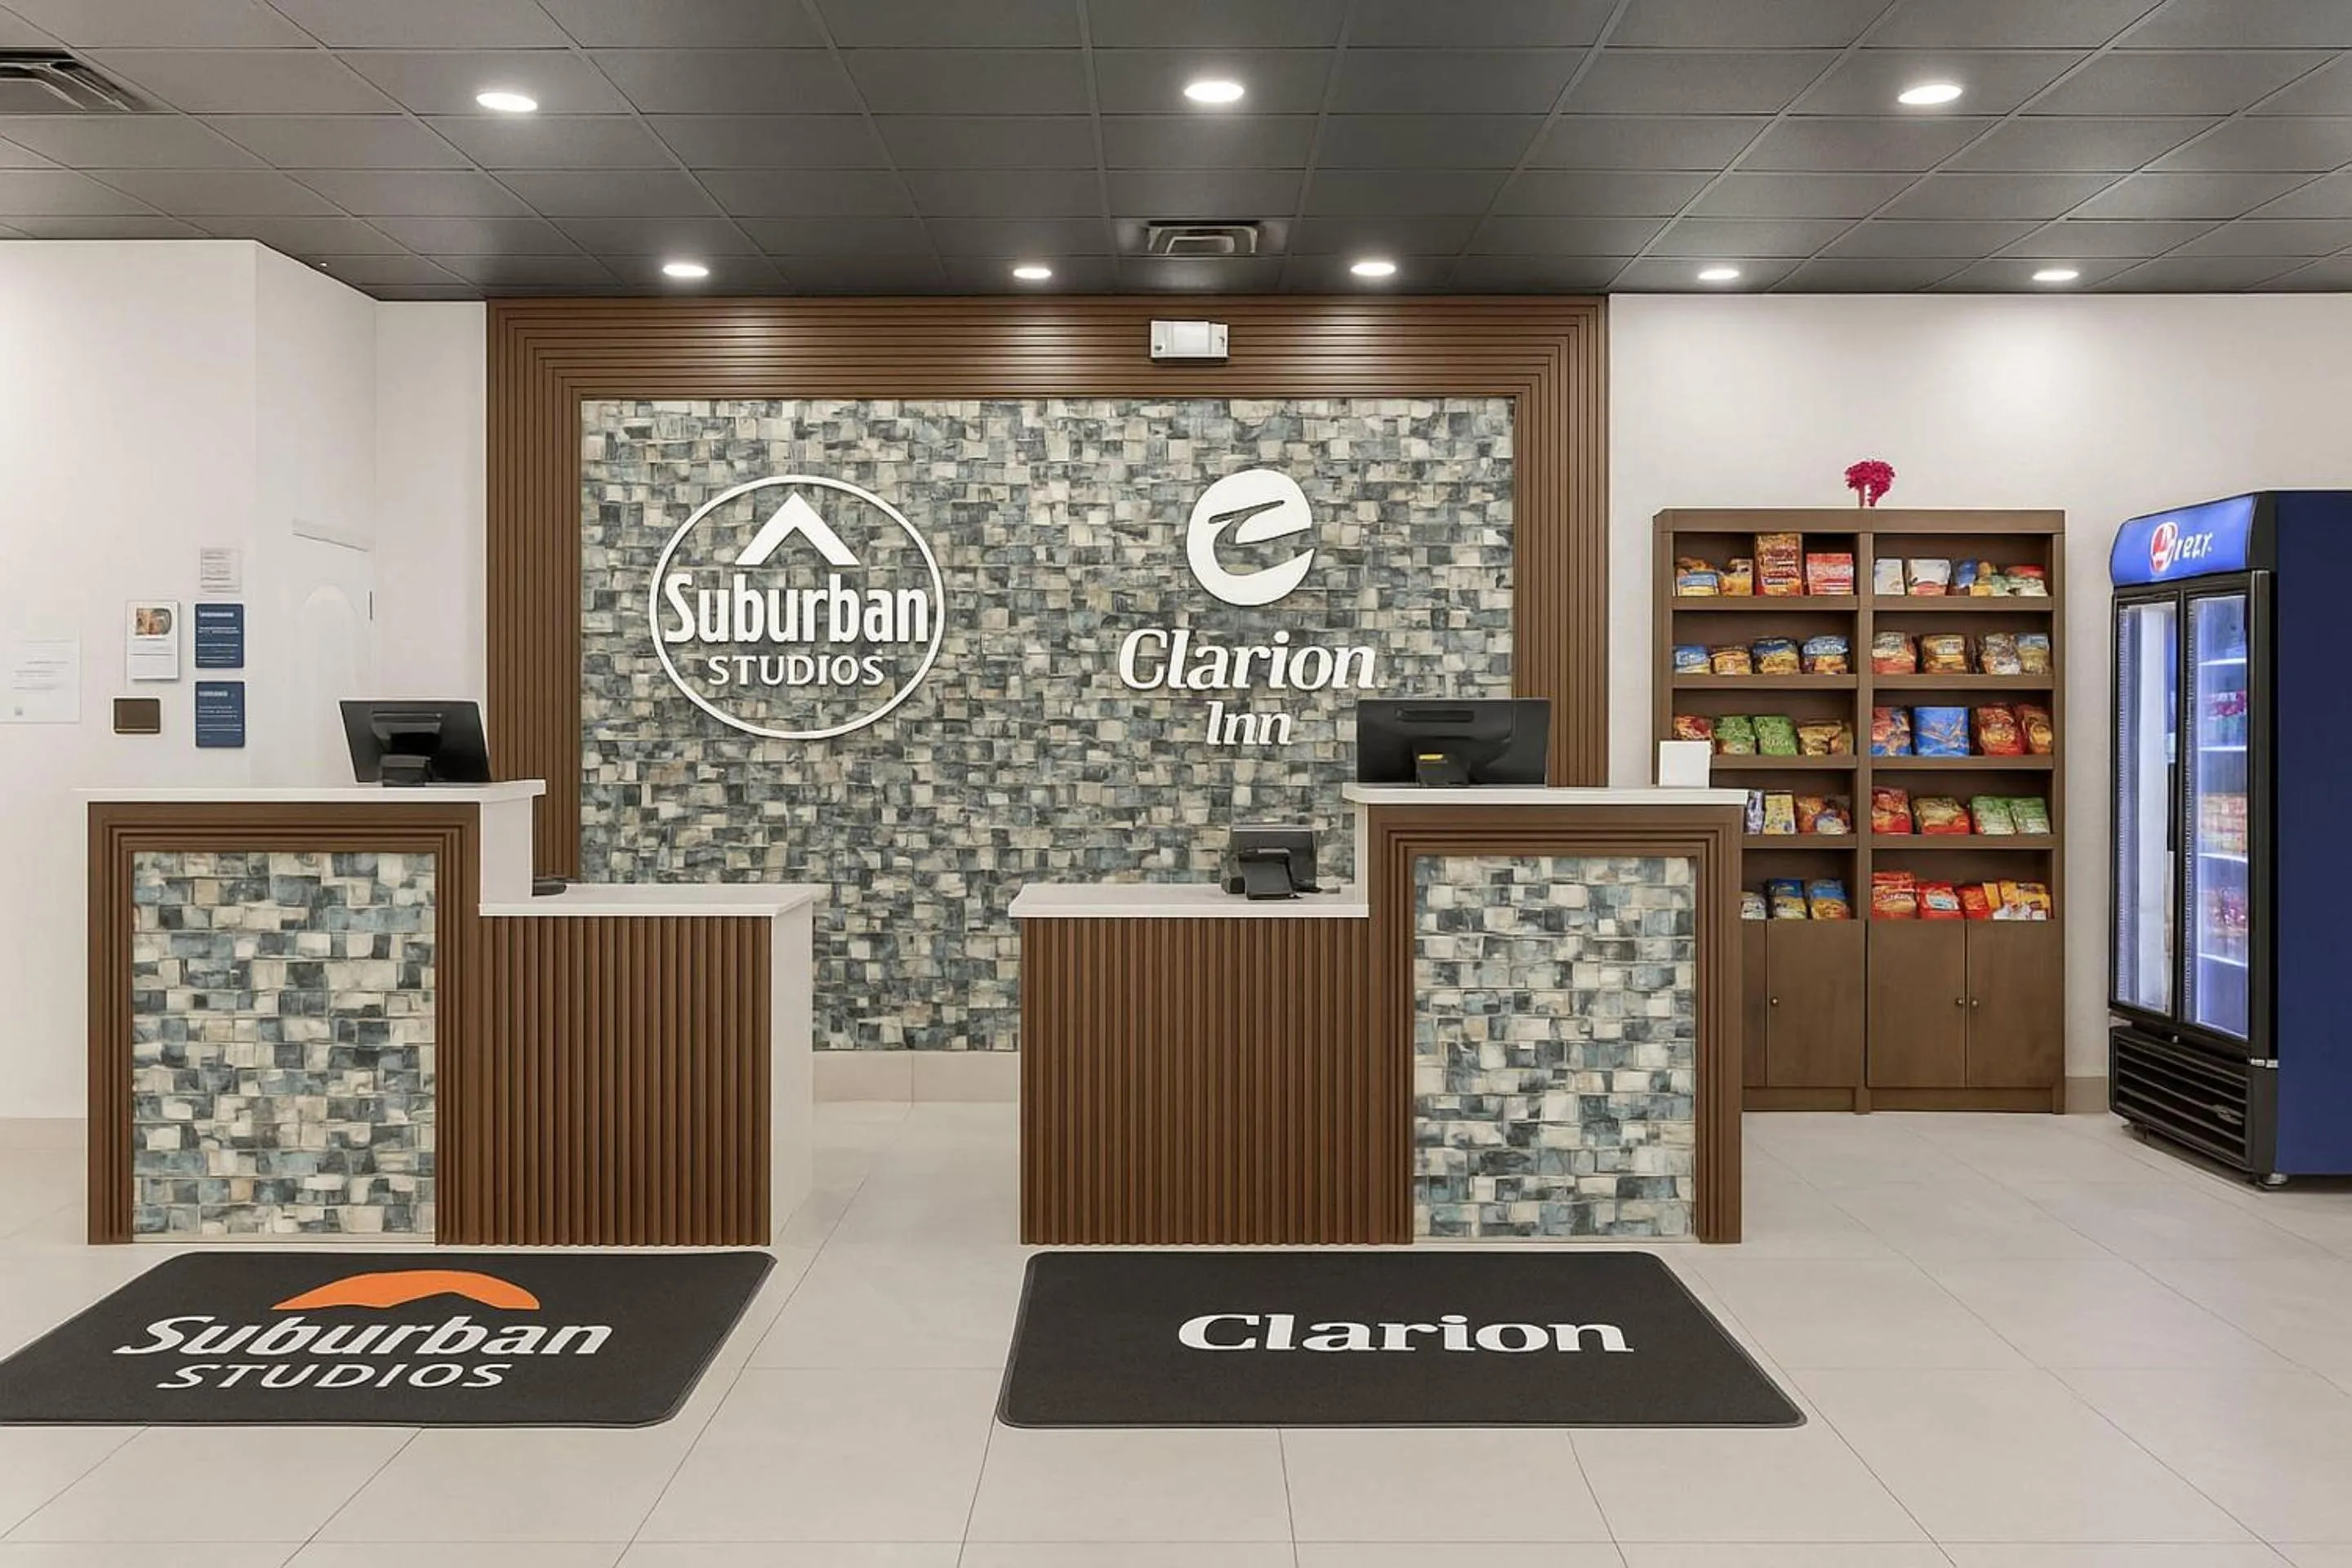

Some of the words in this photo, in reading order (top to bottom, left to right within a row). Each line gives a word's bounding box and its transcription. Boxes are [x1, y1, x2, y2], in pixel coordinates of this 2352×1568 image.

[664, 573, 929, 644] Suburban
[708, 656, 885, 686] STUDIOS
[1119, 629, 1376, 690] Clarion
[1206, 701, 1292, 746] Inn
[112, 1316, 613, 1355] Suburban
[1178, 1314, 1634, 1352] Clarion
[156, 1363, 512, 1389] STUDIOS
